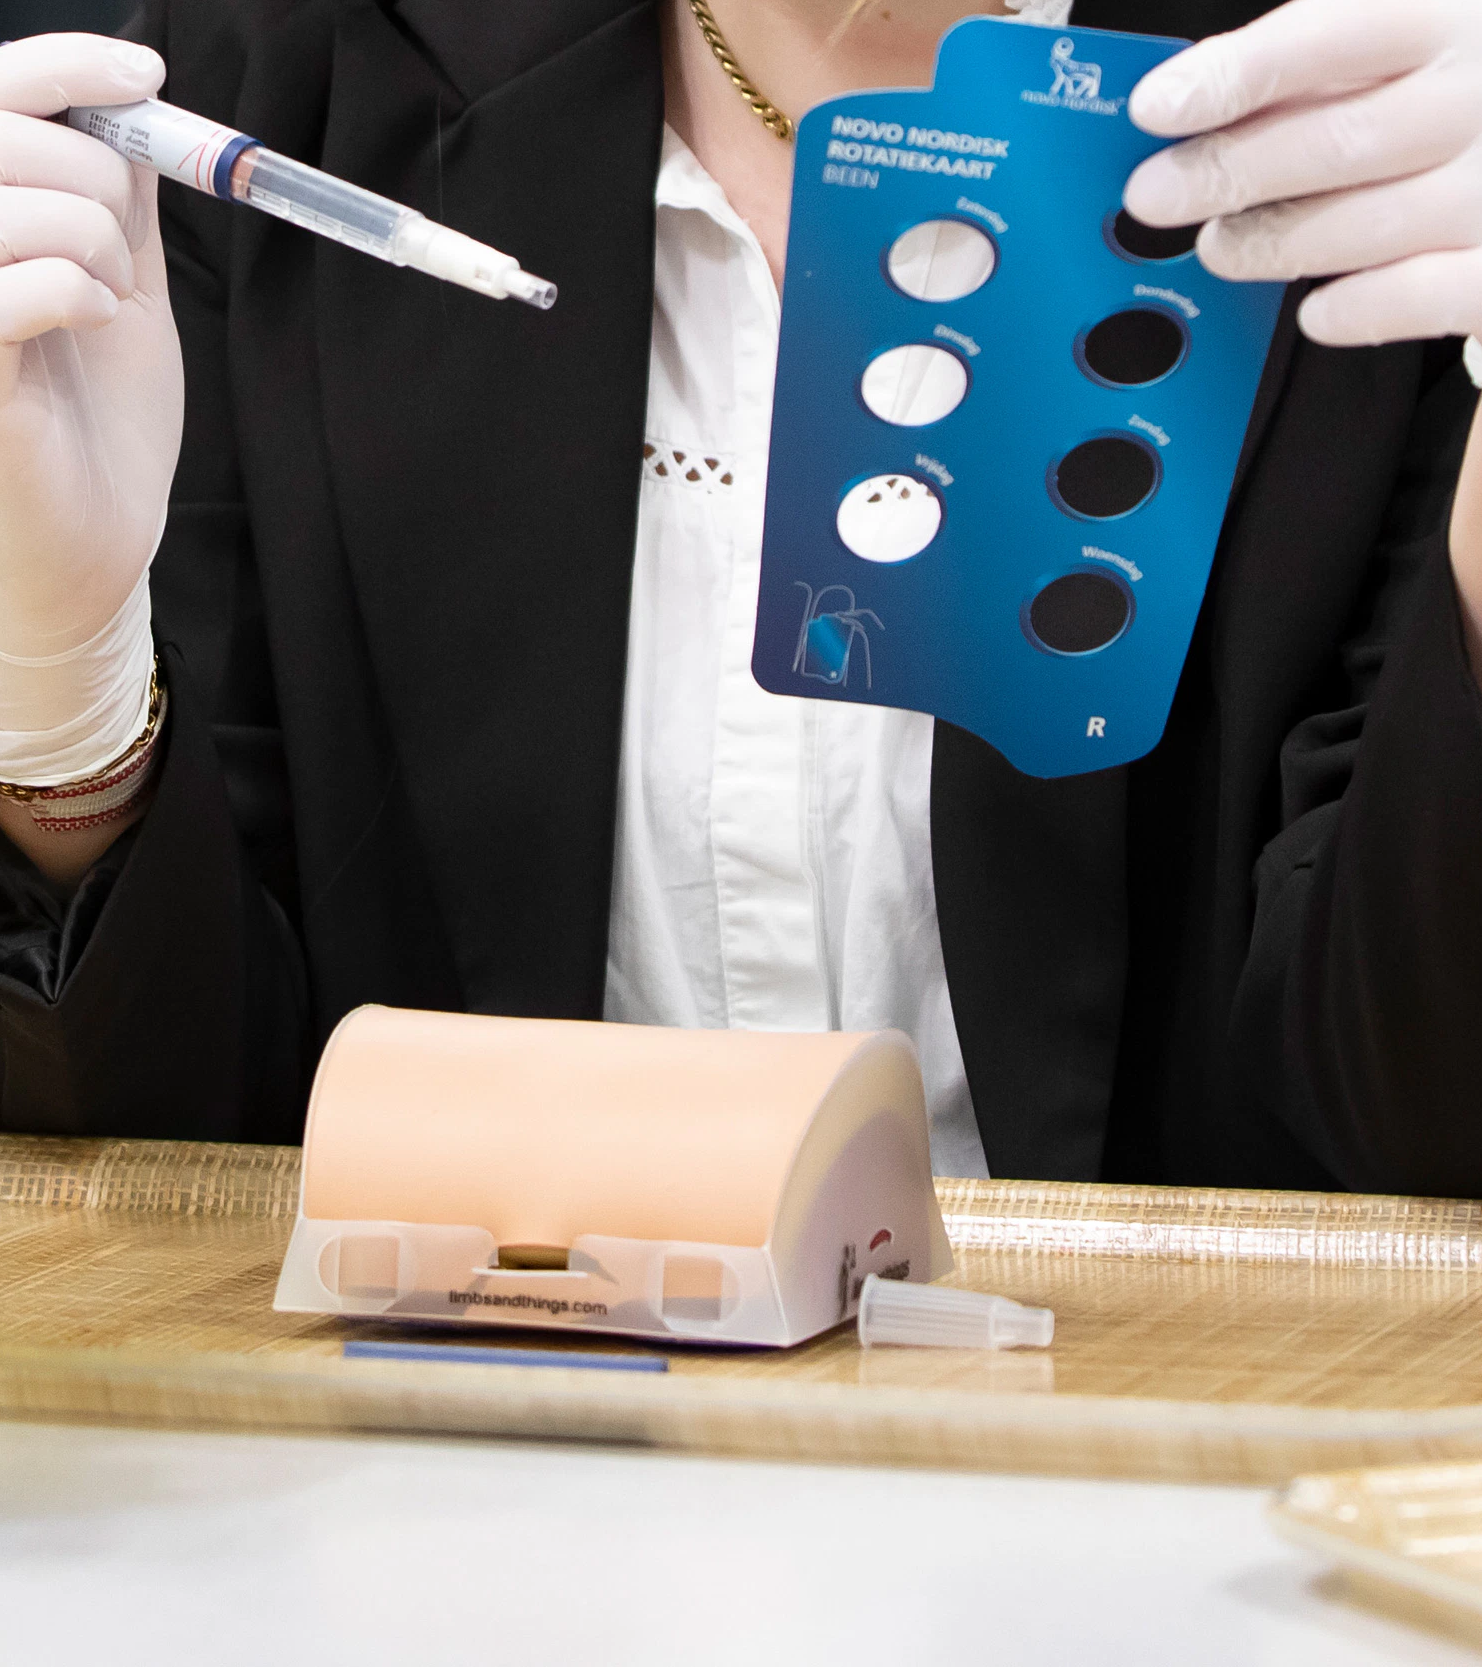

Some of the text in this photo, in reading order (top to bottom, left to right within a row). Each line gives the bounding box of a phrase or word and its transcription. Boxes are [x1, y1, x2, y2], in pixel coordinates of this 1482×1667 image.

[831, 115, 1010, 158] NOVO NORDISK
[826, 139, 997, 180] ROTATIEKAART
[822, 163, 880, 189] BEEN
[1081, 545, 1144, 582] Woensdag
[1086, 716, 1106, 737] R
[449, 1289, 608, 1315] limbsandthings.com
